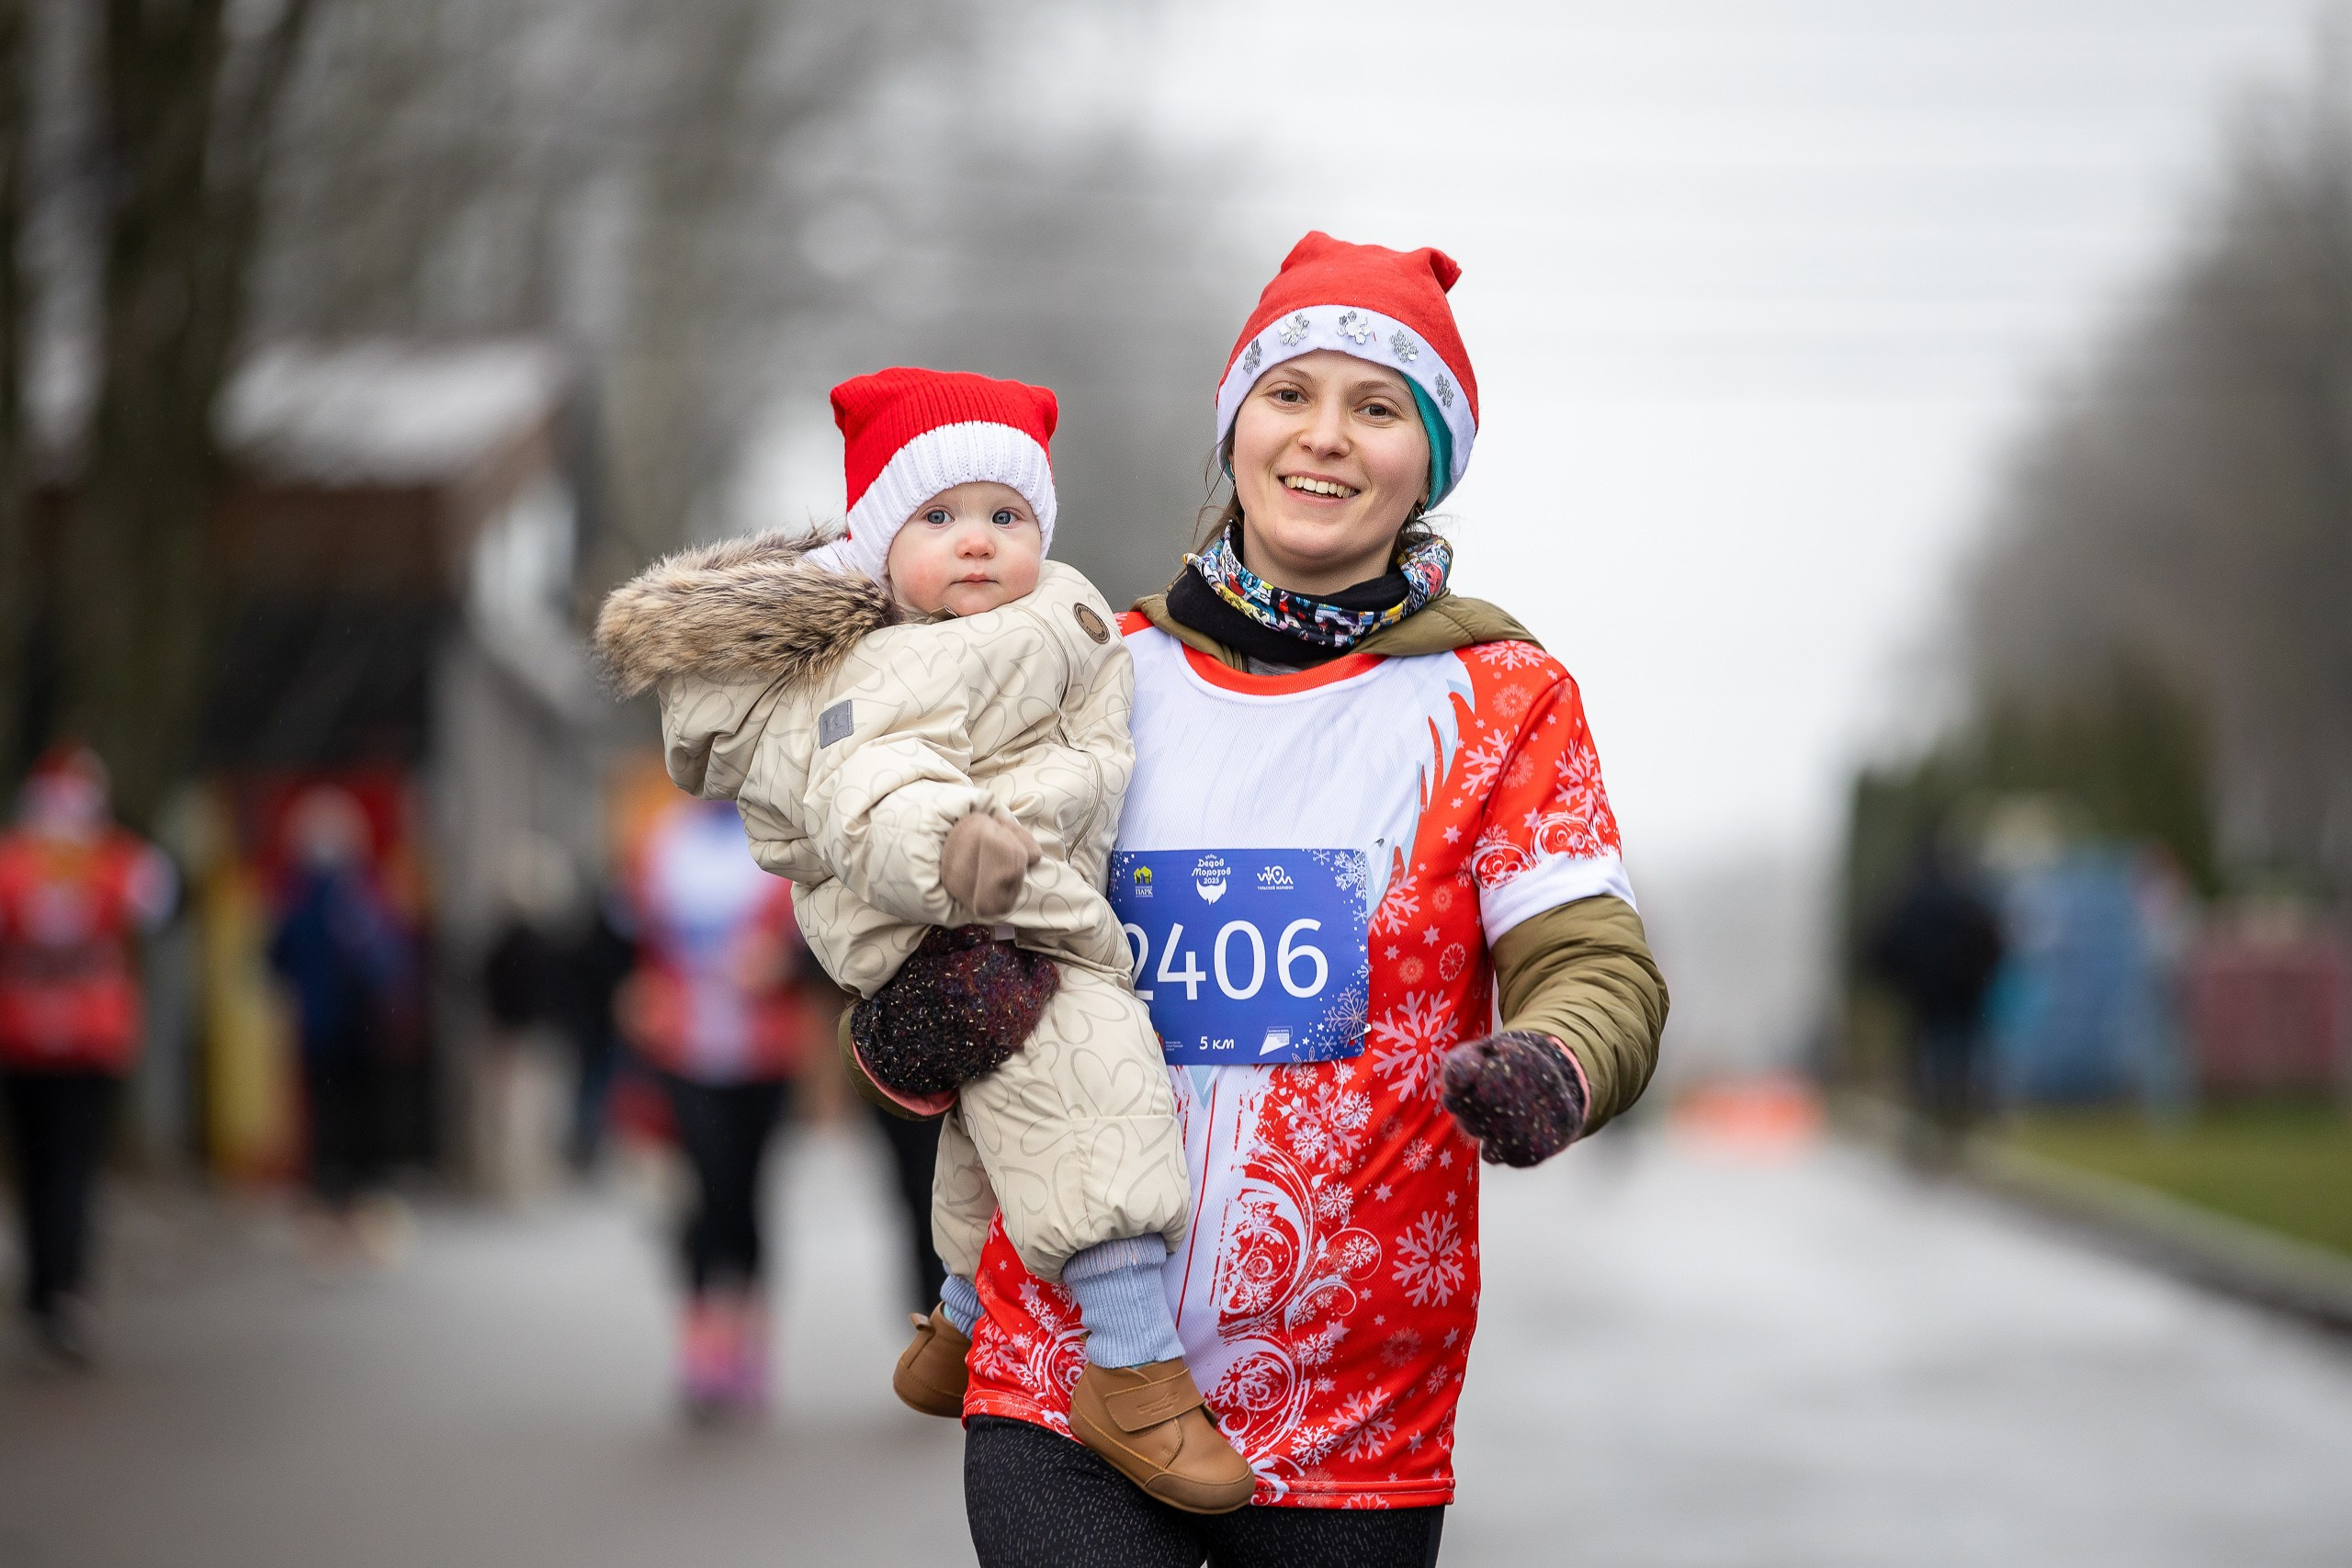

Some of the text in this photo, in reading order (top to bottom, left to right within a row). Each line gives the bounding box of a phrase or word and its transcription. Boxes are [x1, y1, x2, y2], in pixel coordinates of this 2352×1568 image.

[1197, 858, 1225, 868] Дедов
[1191, 866, 1231, 877] Морозов
[1123, 918, 1329, 1001] 2406
[1199, 1035, 1208, 1050] 5
